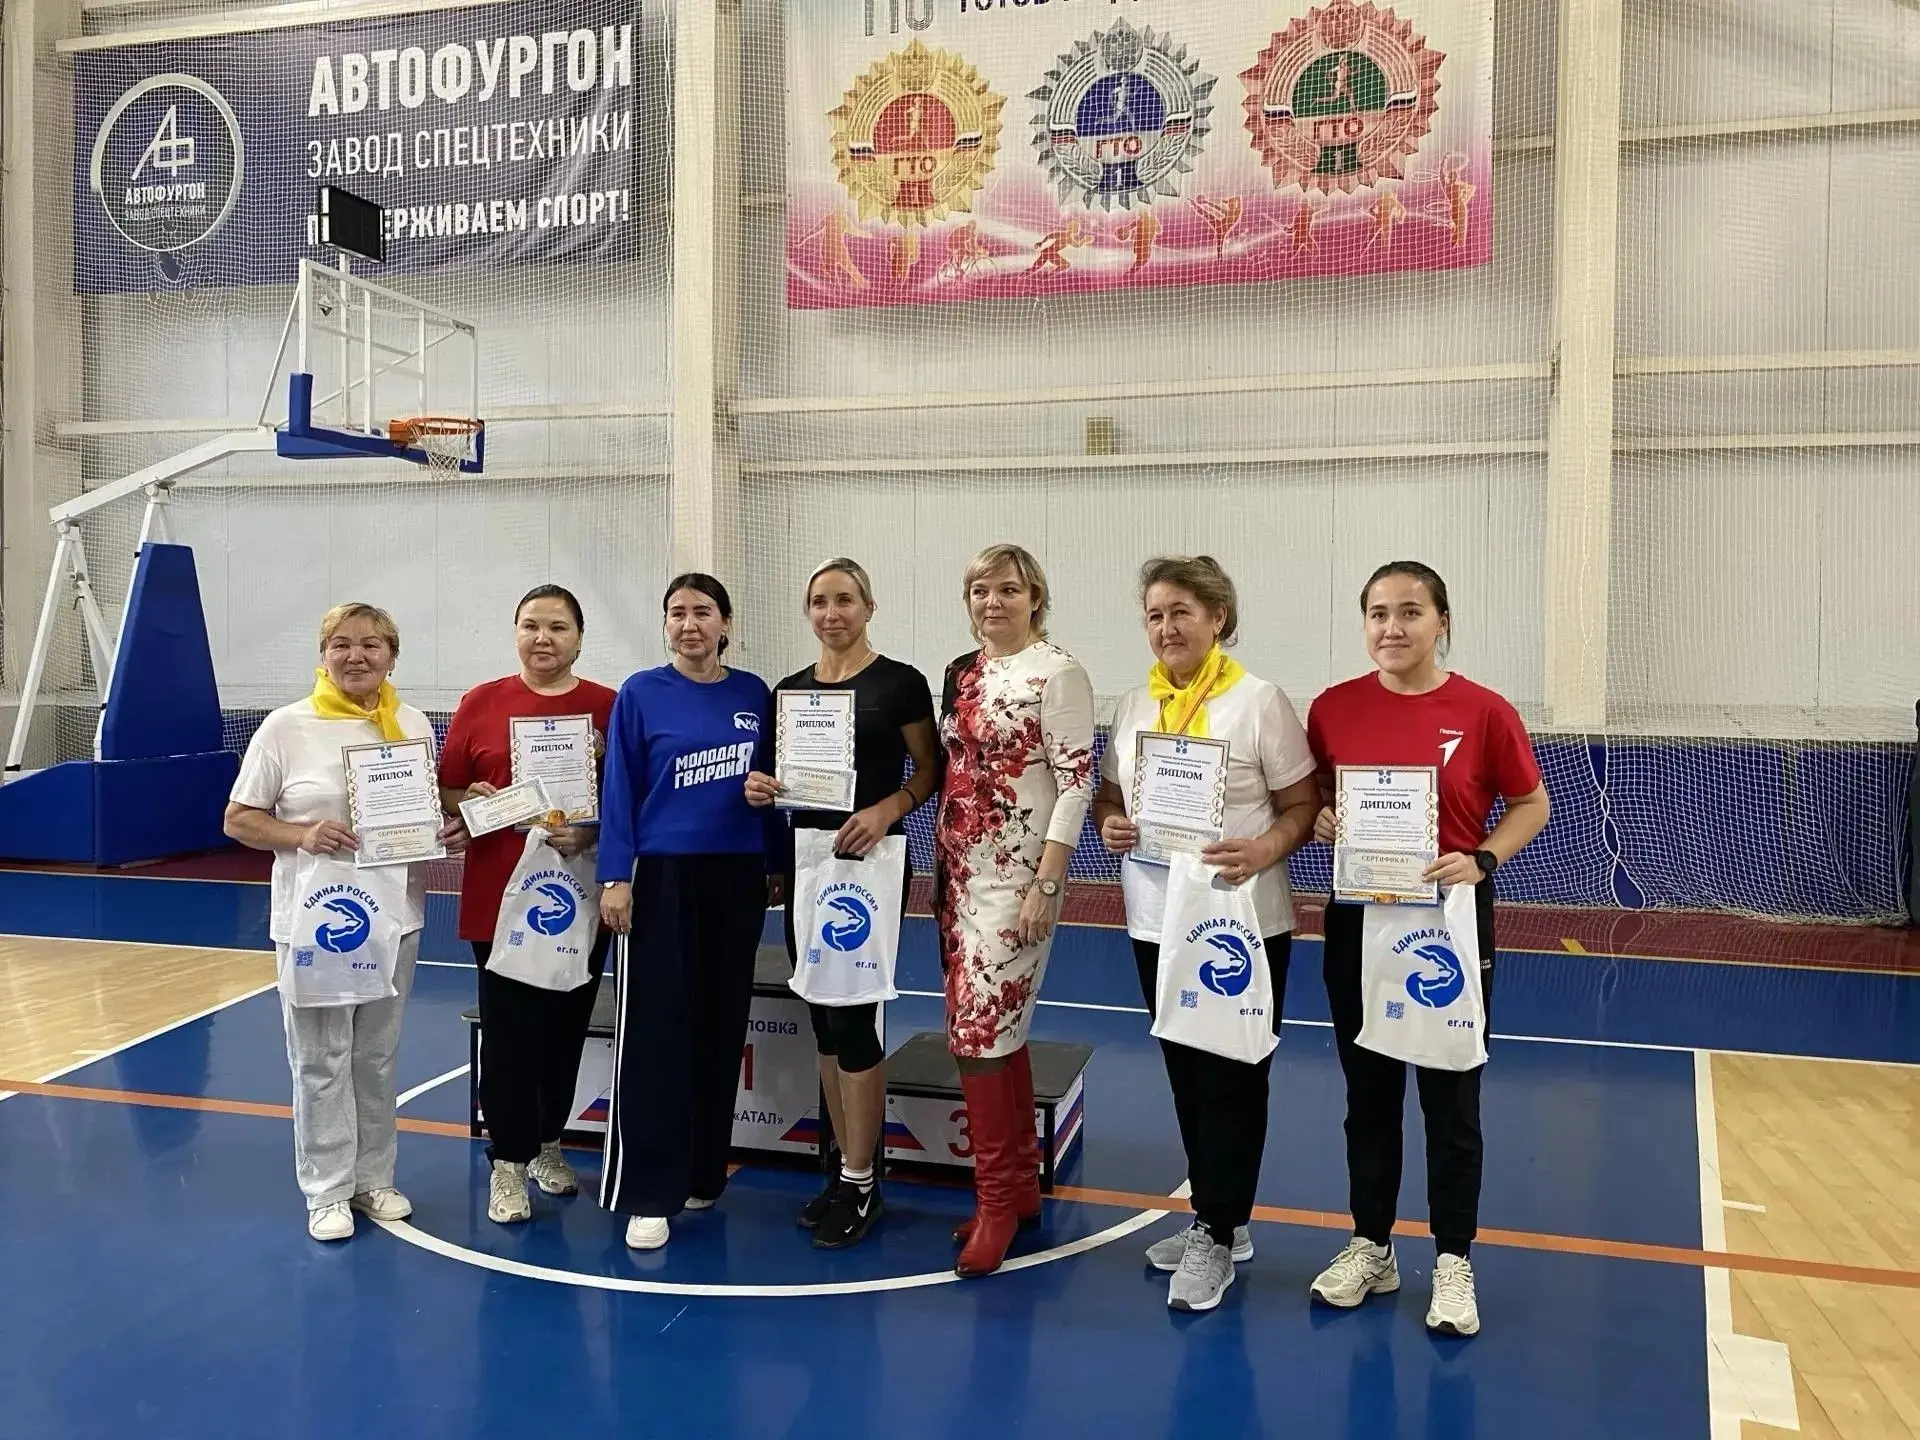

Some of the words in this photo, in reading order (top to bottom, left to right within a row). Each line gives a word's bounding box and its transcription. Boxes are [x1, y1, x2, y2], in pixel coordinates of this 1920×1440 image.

[307, 24, 632, 117] АВТОФУРГОН
[1312, 116, 1365, 140] ГТО
[306, 132, 404, 179] ЗАВОД
[414, 110, 631, 170] СПЕЦТЕХНИКИ
[1095, 135, 1143, 158] ГТО
[893, 155, 937, 175] ГТО
[124, 182, 206, 205] АВТОФУРГОН
[307, 199, 527, 245] ПЕРЖИВАЕМ
[536, 189, 630, 229] СПОРТ!
[795, 720, 836, 729] ДИПЛОМ
[530, 743, 574, 753] ДИПЛОМ
[675, 742, 754, 773] МОЛОДАЯ
[367, 769, 414, 784] ДИПЛОМ
[1156, 766, 1204, 781] ДИПЛОМ
[1359, 800, 1412, 811] ДИПЛОМ
[377, 827, 420, 838] СЕРТИФИКАТ
[1361, 855, 1410, 864] СЕРТИФИКАТ
[521, 869, 555, 892] ЕДИНАЯ
[557, 871, 588, 901] РОССИЯ
[303, 884, 344, 910] ЕДИНАЯ
[346, 885, 380, 913] РОССИЯ
[816, 882, 847, 908] ЕДИНАЯ
[849, 883, 880, 912] РОССИЯ
[1186, 918, 1227, 944] ЕДИНАЯ
[1229, 919, 1262, 950] РОССИЯ
[1392, 928, 1435, 955] ЕДИНАЯ
[556, 945, 579, 954] er.ru
[352, 962, 377, 970] er.ru
[855, 960, 878, 970] er.ru
[1239, 1006, 1264, 1016] er.ru
[1447, 1019, 1475, 1029] er.ru
[733, 1110, 785, 1126] «АТАЛ»
[947, 1109, 977, 1158] 3
